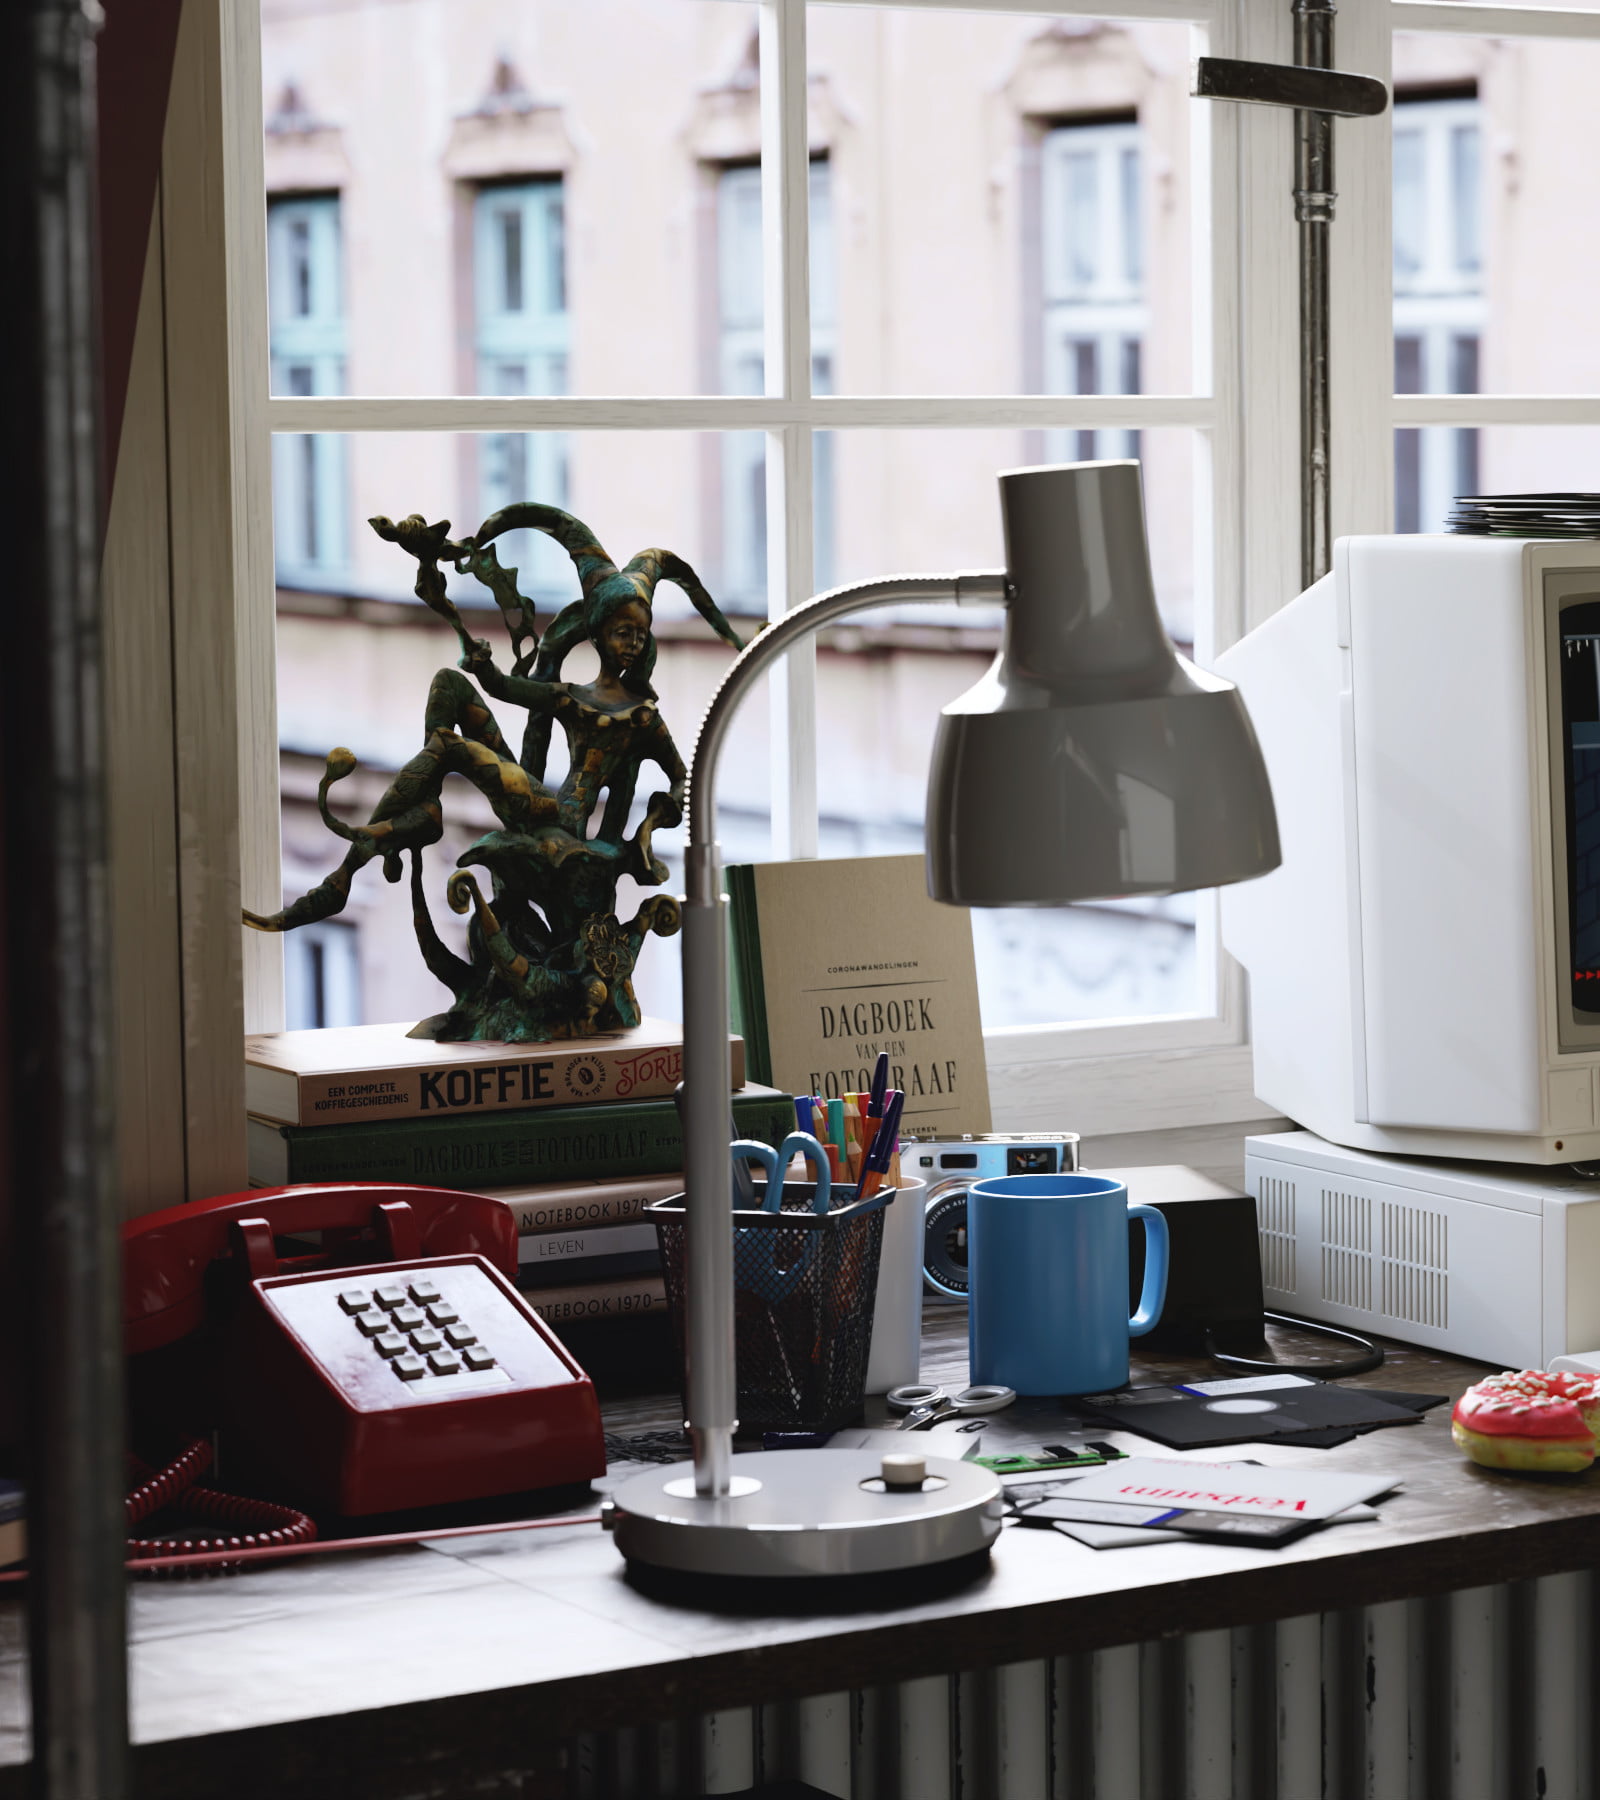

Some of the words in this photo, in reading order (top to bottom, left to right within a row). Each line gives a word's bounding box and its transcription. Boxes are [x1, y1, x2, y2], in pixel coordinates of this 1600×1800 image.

[827, 961, 919, 974] CORONAWANDELINGEN
[820, 998, 935, 1038] DAGBOEK
[856, 1042, 879, 1059] VAN
[885, 1040, 906, 1057] EEN
[565, 1057, 582, 1086] BRANDER
[810, 1061, 957, 1098] FOTORAAF
[328, 1087, 346, 1098] EEN
[348, 1082, 396, 1096] COMPLETE
[420, 1062, 554, 1109] KOFFIE
[570, 1087, 583, 1097] VAN
[592, 1084, 603, 1095] TOT
[315, 1093, 409, 1111] KOFFIEGESCHIEDENIS
[414, 1142, 498, 1173] DAGBOEK
[536, 1131, 647, 1164] FOTOGRAAF
[522, 1202, 610, 1227] NOTEBOOK
[926, 1204, 951, 1229] FUJINON
[539, 1240, 584, 1256] LEVEN
[534, 1298, 610, 1319] OTEBOOK
[1119, 1486, 1306, 1511] Verbatim
